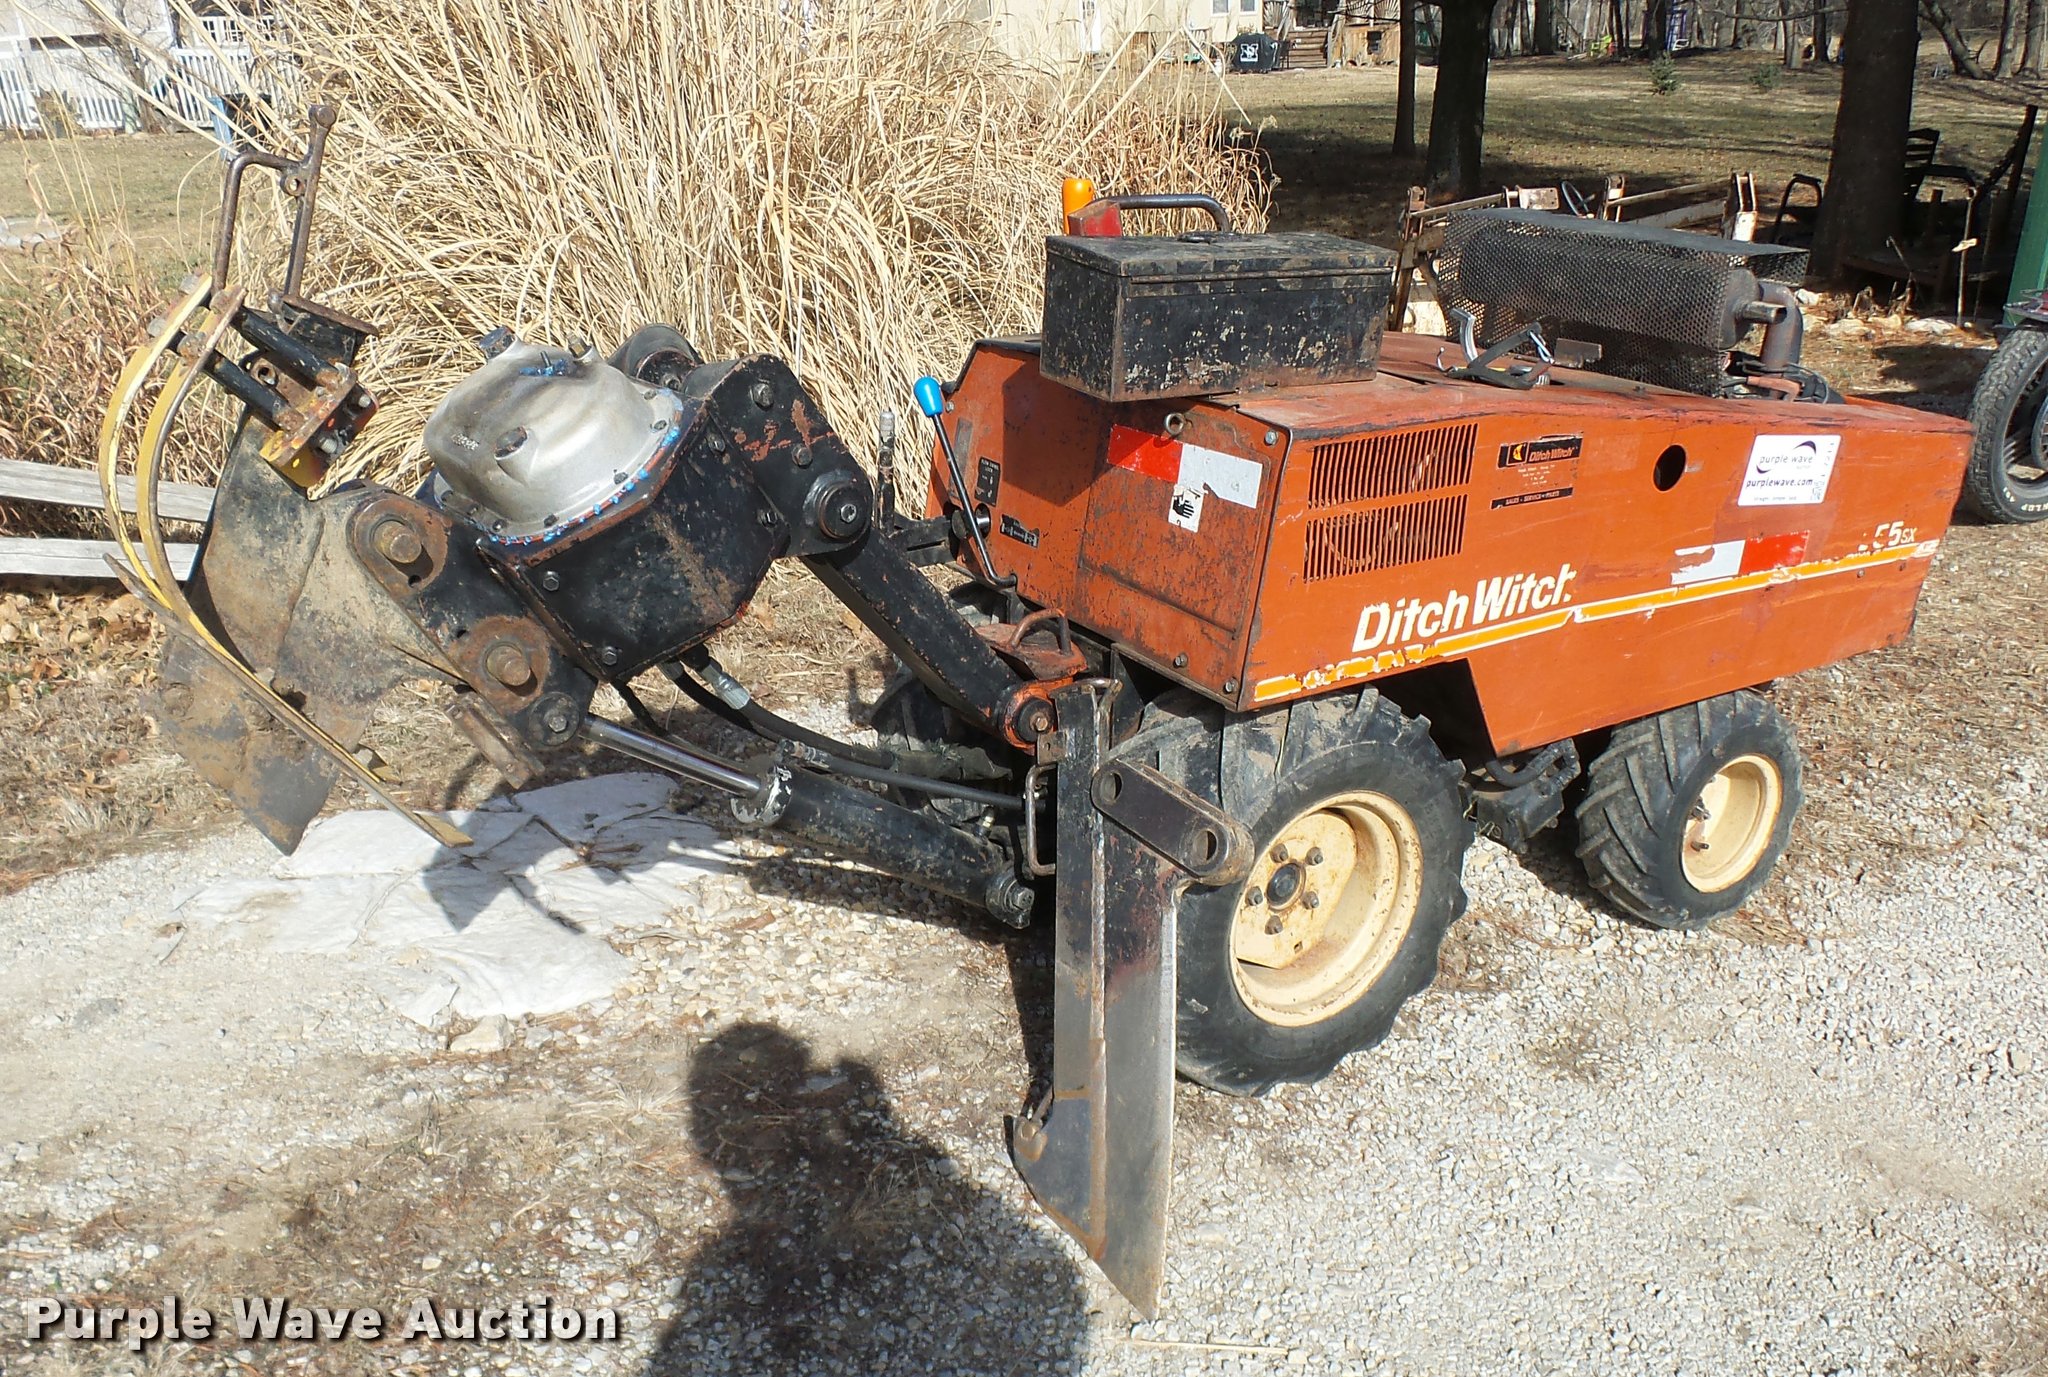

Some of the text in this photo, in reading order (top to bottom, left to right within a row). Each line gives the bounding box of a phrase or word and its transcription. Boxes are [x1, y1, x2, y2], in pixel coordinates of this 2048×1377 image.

[1528, 446, 1574, 463] Ditch Witch
[1759, 454, 1814, 464] purple wave
[1745, 477, 1814, 489] purplewave.com
[1352, 563, 1578, 653] Ditch Witch
